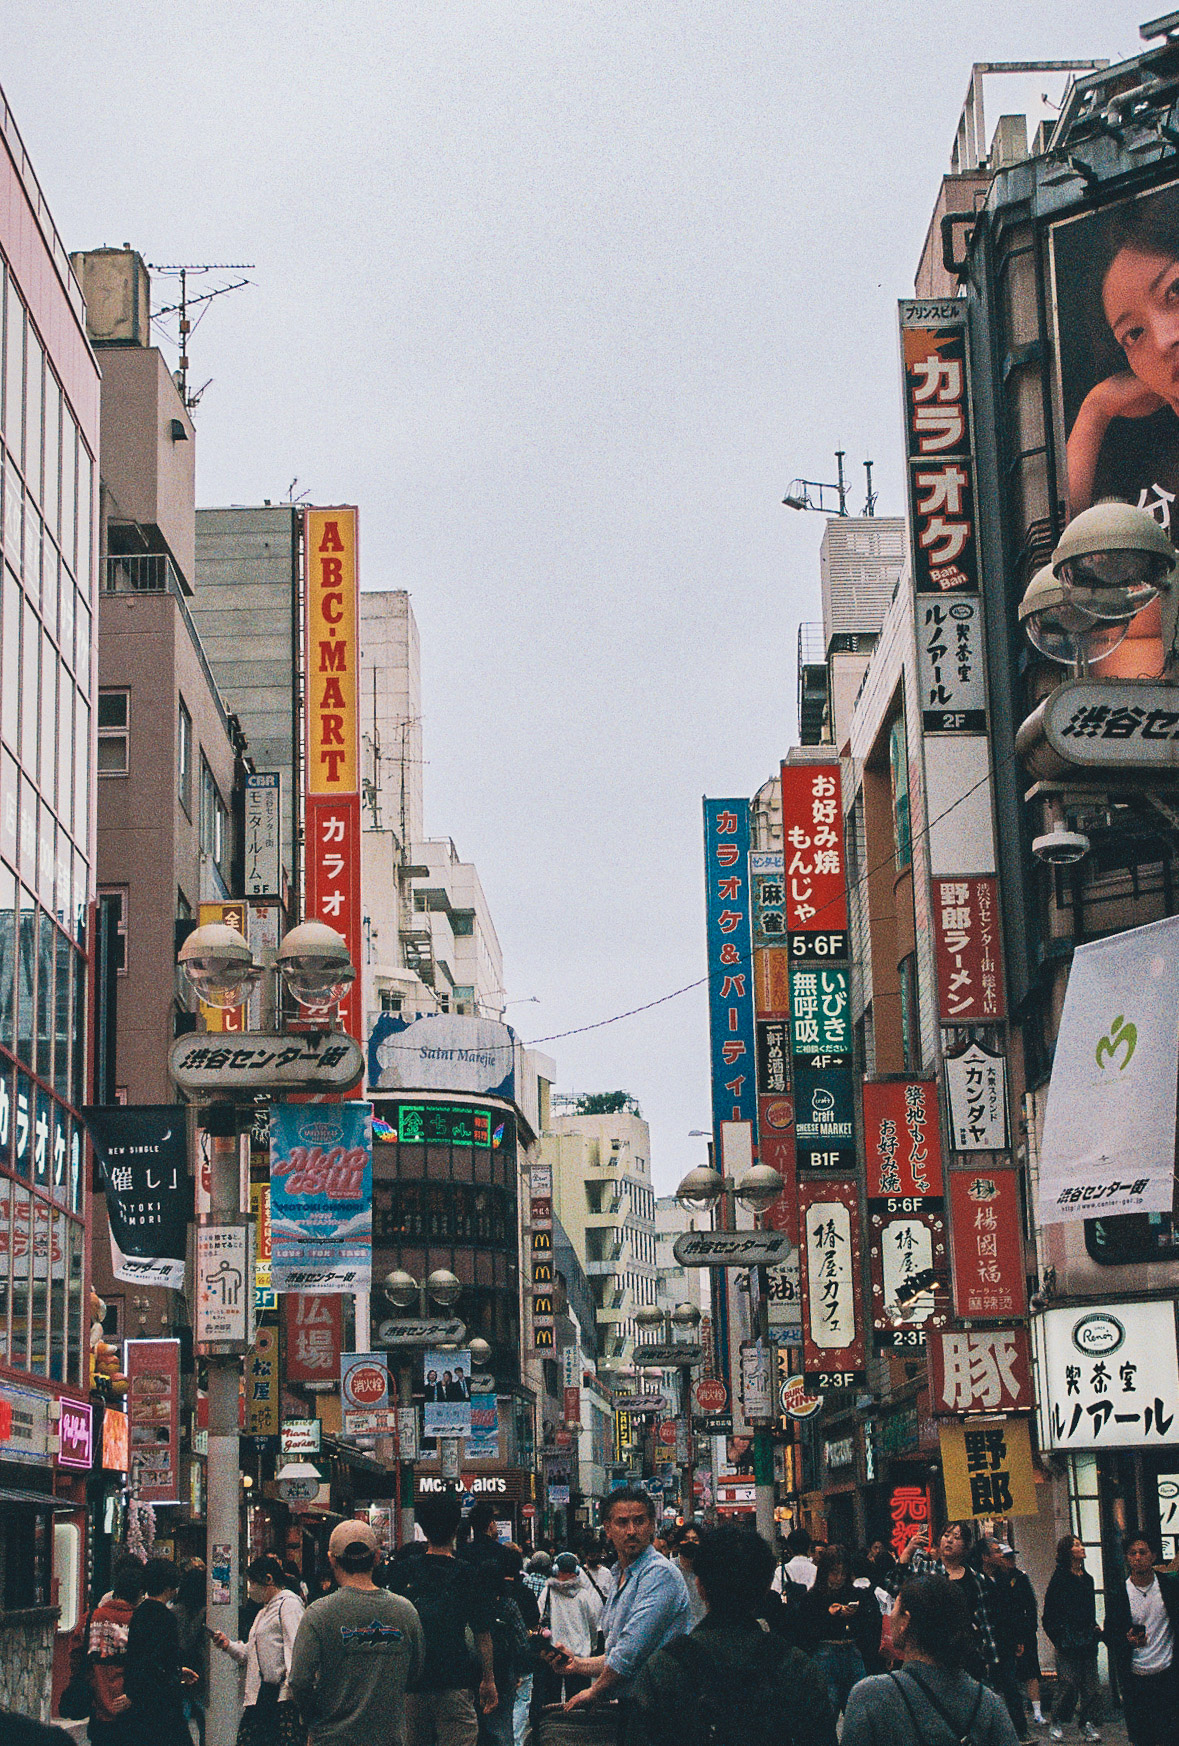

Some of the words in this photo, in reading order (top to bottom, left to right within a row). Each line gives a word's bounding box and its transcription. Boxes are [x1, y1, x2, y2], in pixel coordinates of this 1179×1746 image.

[912, 356, 969, 566] カラオケ
[924, 604, 953, 706] ルノアール
[942, 713, 966, 728] 2F
[1061, 705, 1179, 739] 渋谷セ
[248, 790, 262, 881] モニタールーム
[811, 774, 840, 875] お好み焼
[253, 884, 269, 894] 5F
[321, 816, 346, 940] カラオ
[786, 825, 817, 922] もんじゃ
[761, 884, 784, 934] 麻雀
[939, 881, 977, 1016] 野郎ラーメン
[792, 971, 820, 1044] 無呼吸
[821, 971, 848, 1042] いびき
[178, 1046, 351, 1070] 渋谷センター街
[765, 1024, 785, 1092] 一軒め酒場
[810, 1055, 832, 1068] 4F
[796, 1122, 819, 1133] CHEESE
[820, 1122, 852, 1135] MARKET
[812, 1109, 835, 1123] Craft
[965, 1067, 986, 1144] カンダヤ
[108, 1146, 125, 1155] NEW
[129, 1145, 161, 1154] SINGLE
[810, 1152, 840, 1166] B1F
[877, 1119, 903, 1195] お好み焼
[904, 1084, 931, 1193] 築地もんじゃ
[1056, 1178, 1150, 1204] 渋谷センター街
[682, 1239, 784, 1255] 渋谷センター街
[973, 1206, 1001, 1284] 楊國福
[812, 1218, 845, 1332] 椿屋カフェ
[1083, 1328, 1114, 1344] Renoir
[252, 1357, 271, 1401] 松屋
[353, 1378, 383, 1393] 消火栓
[941, 1330, 1021, 1409] 豚
[1065, 1360, 1137, 1396] 喫茶室
[1052, 1396, 1175, 1441] ルノアール
[419, 1477, 507, 1493] Mcoald's
[963, 1429, 1014, 1516] 野郎
